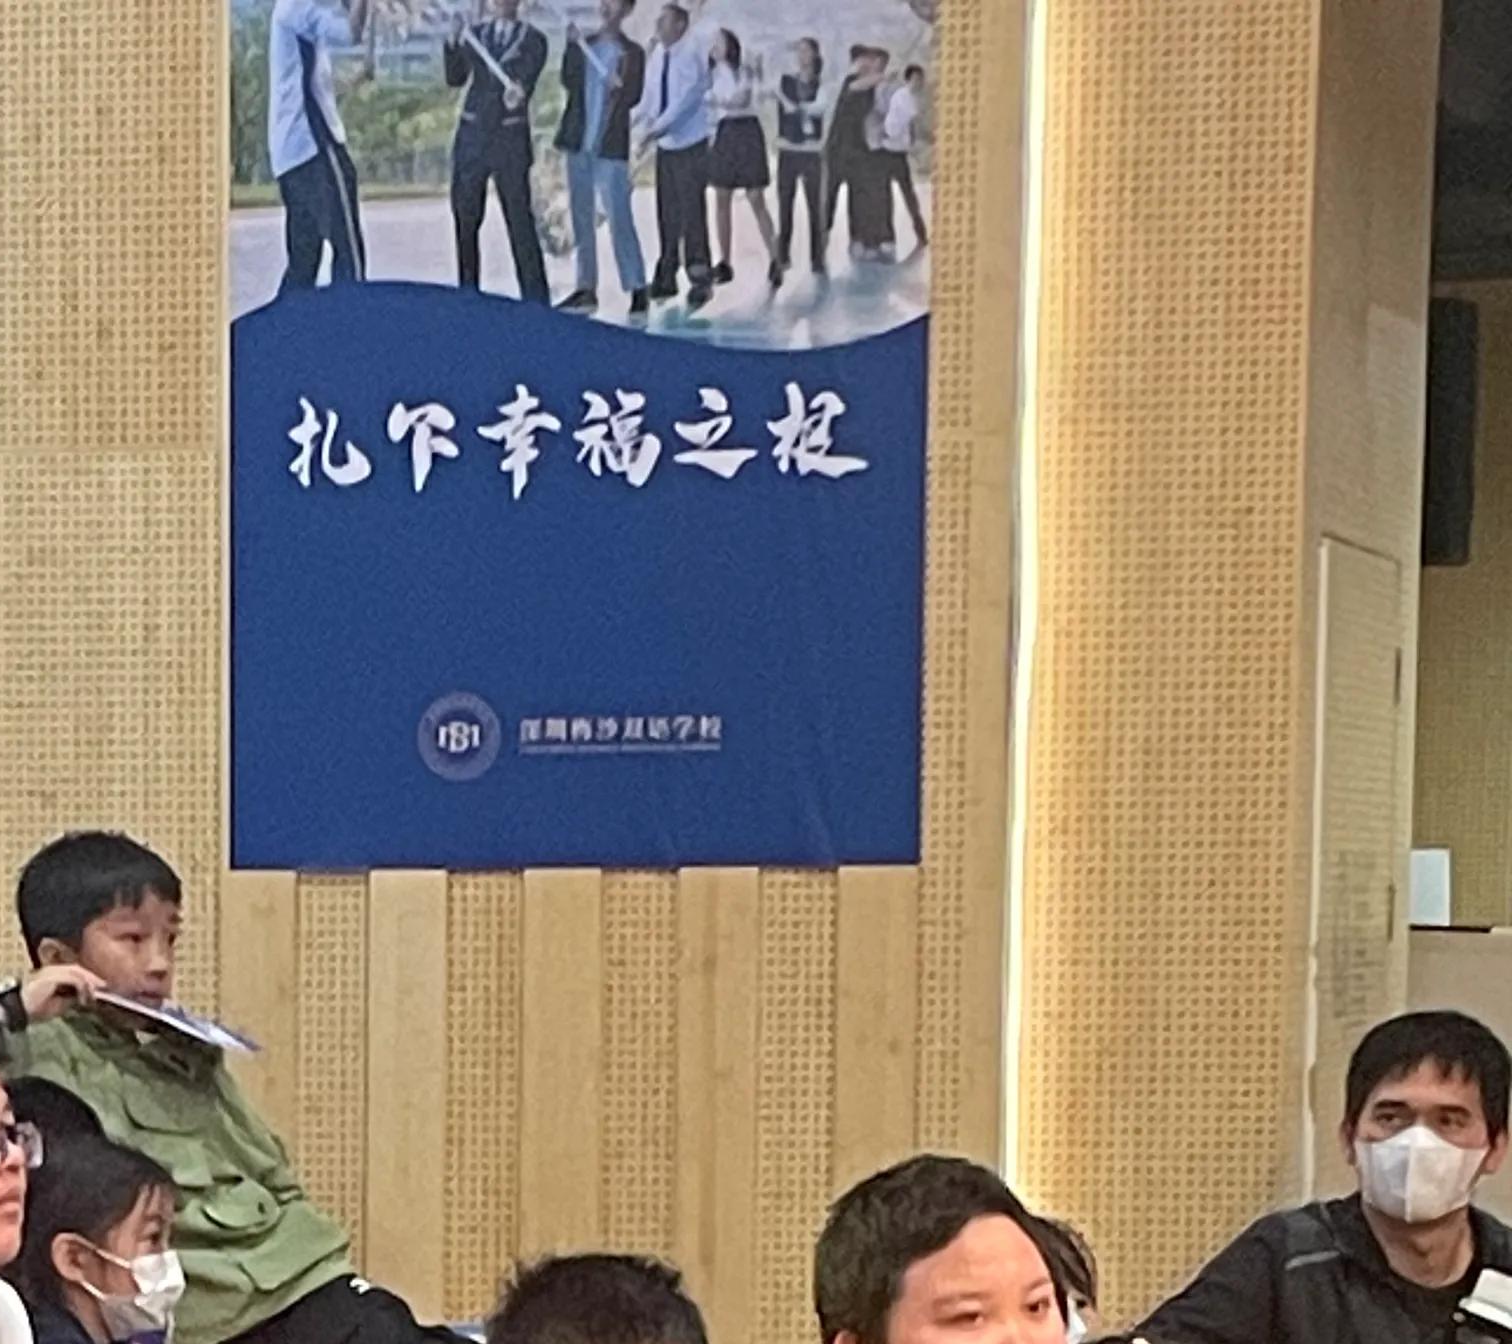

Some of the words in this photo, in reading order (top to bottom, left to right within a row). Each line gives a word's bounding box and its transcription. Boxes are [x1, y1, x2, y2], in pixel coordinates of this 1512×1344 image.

[288, 384, 869, 500] 扎下幸福之根
